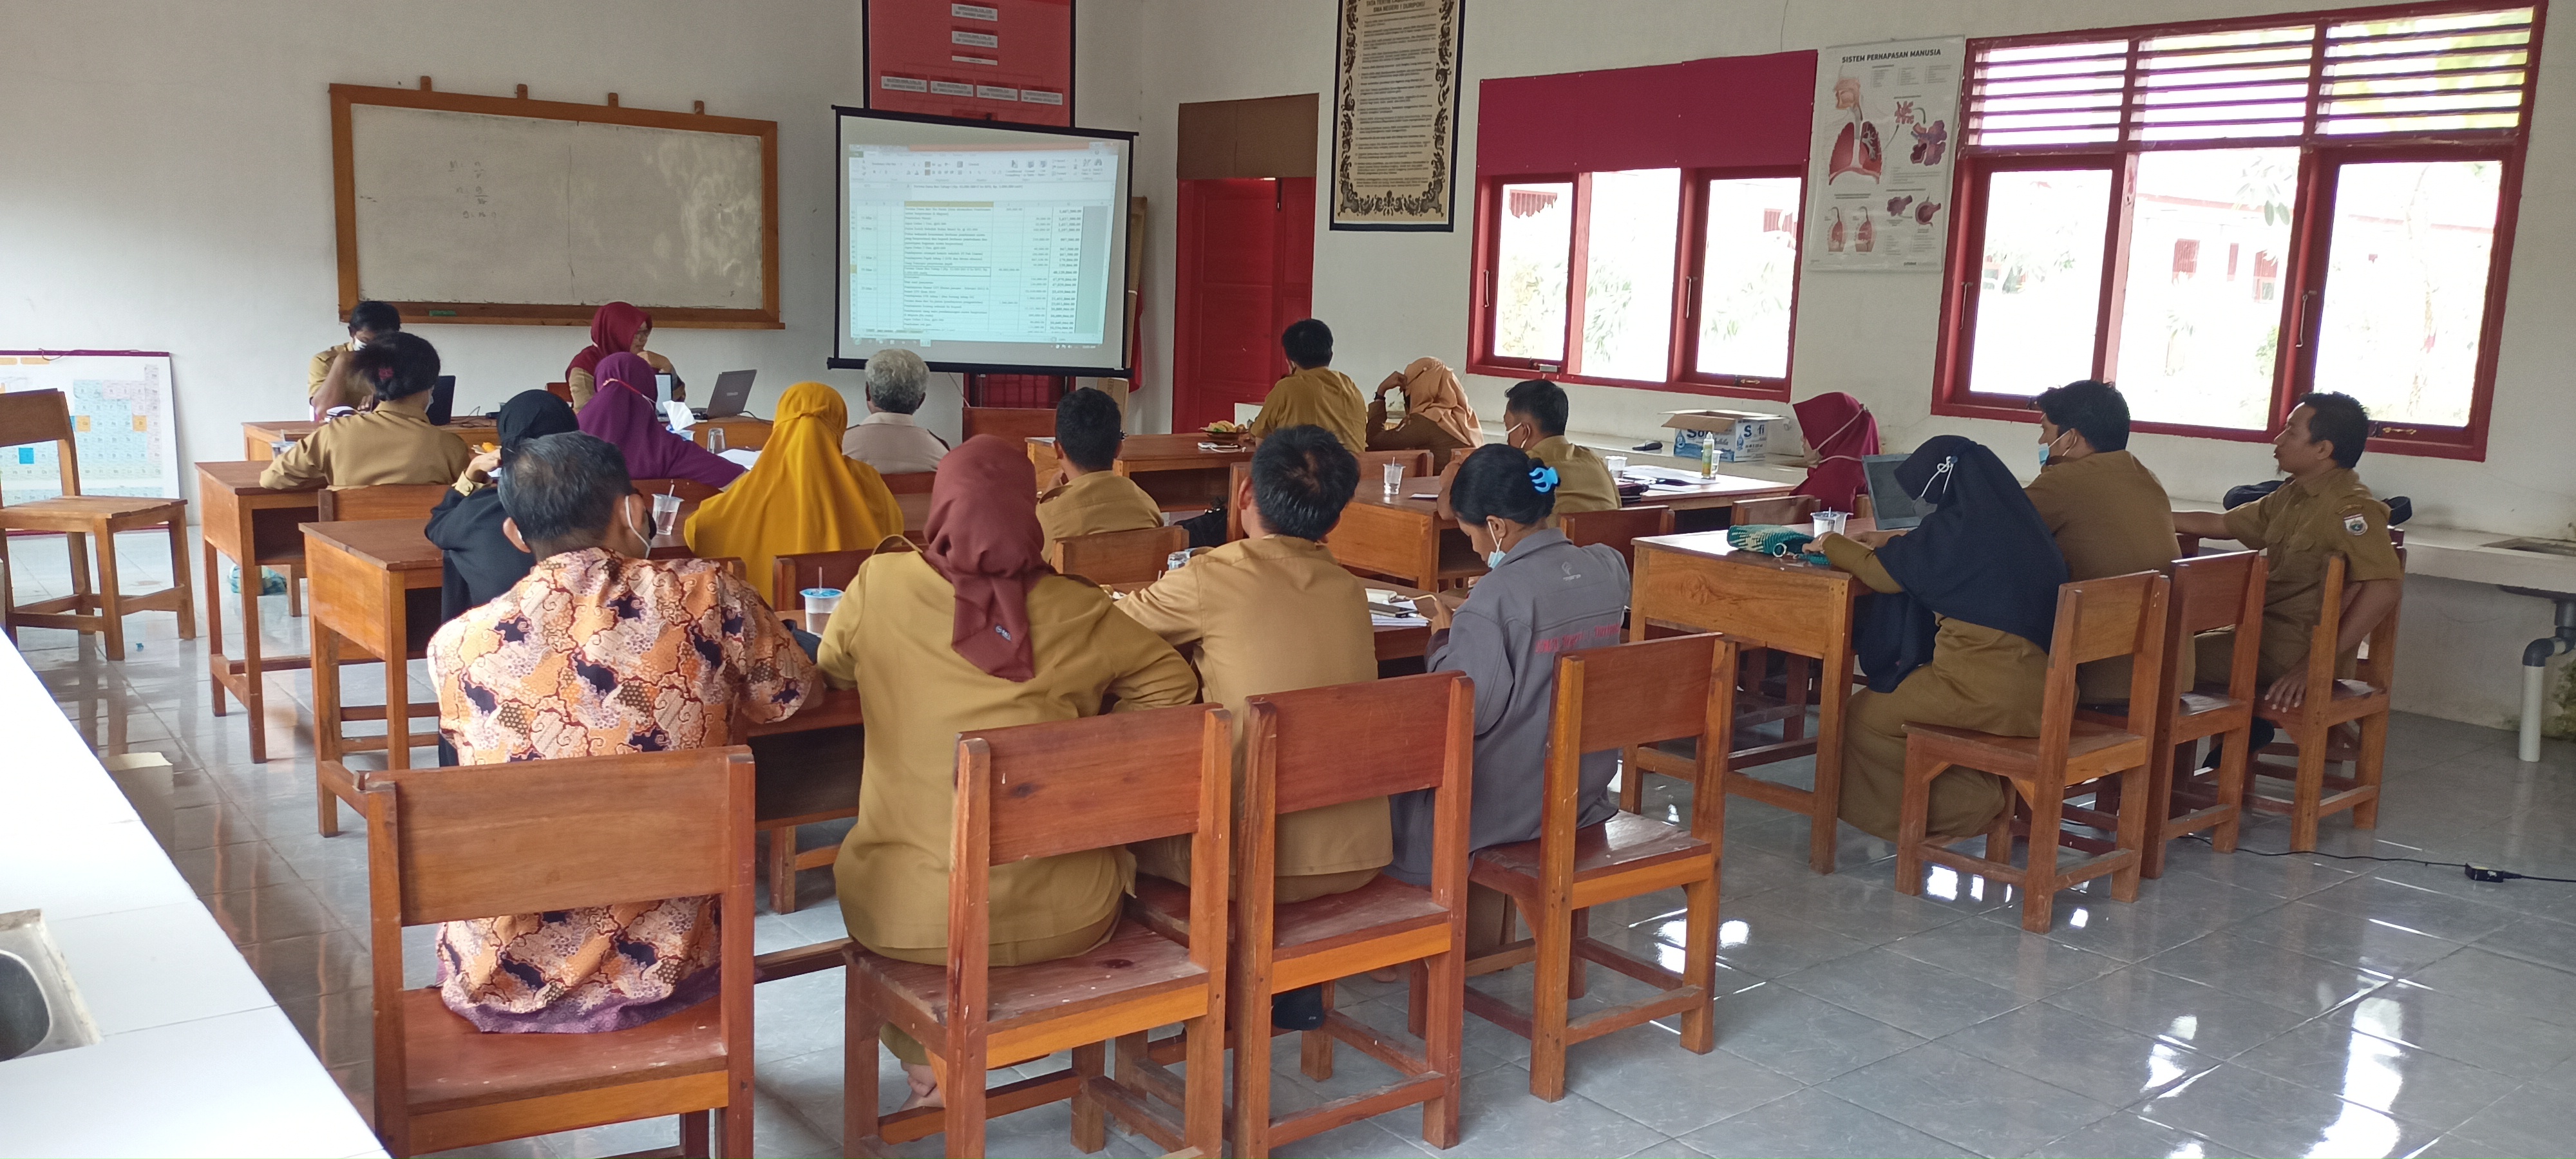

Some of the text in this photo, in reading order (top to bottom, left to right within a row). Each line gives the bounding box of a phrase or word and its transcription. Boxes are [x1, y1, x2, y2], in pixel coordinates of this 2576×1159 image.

[1842, 49, 1941, 63] SISTEM PERNAPASAN MANUSIA
